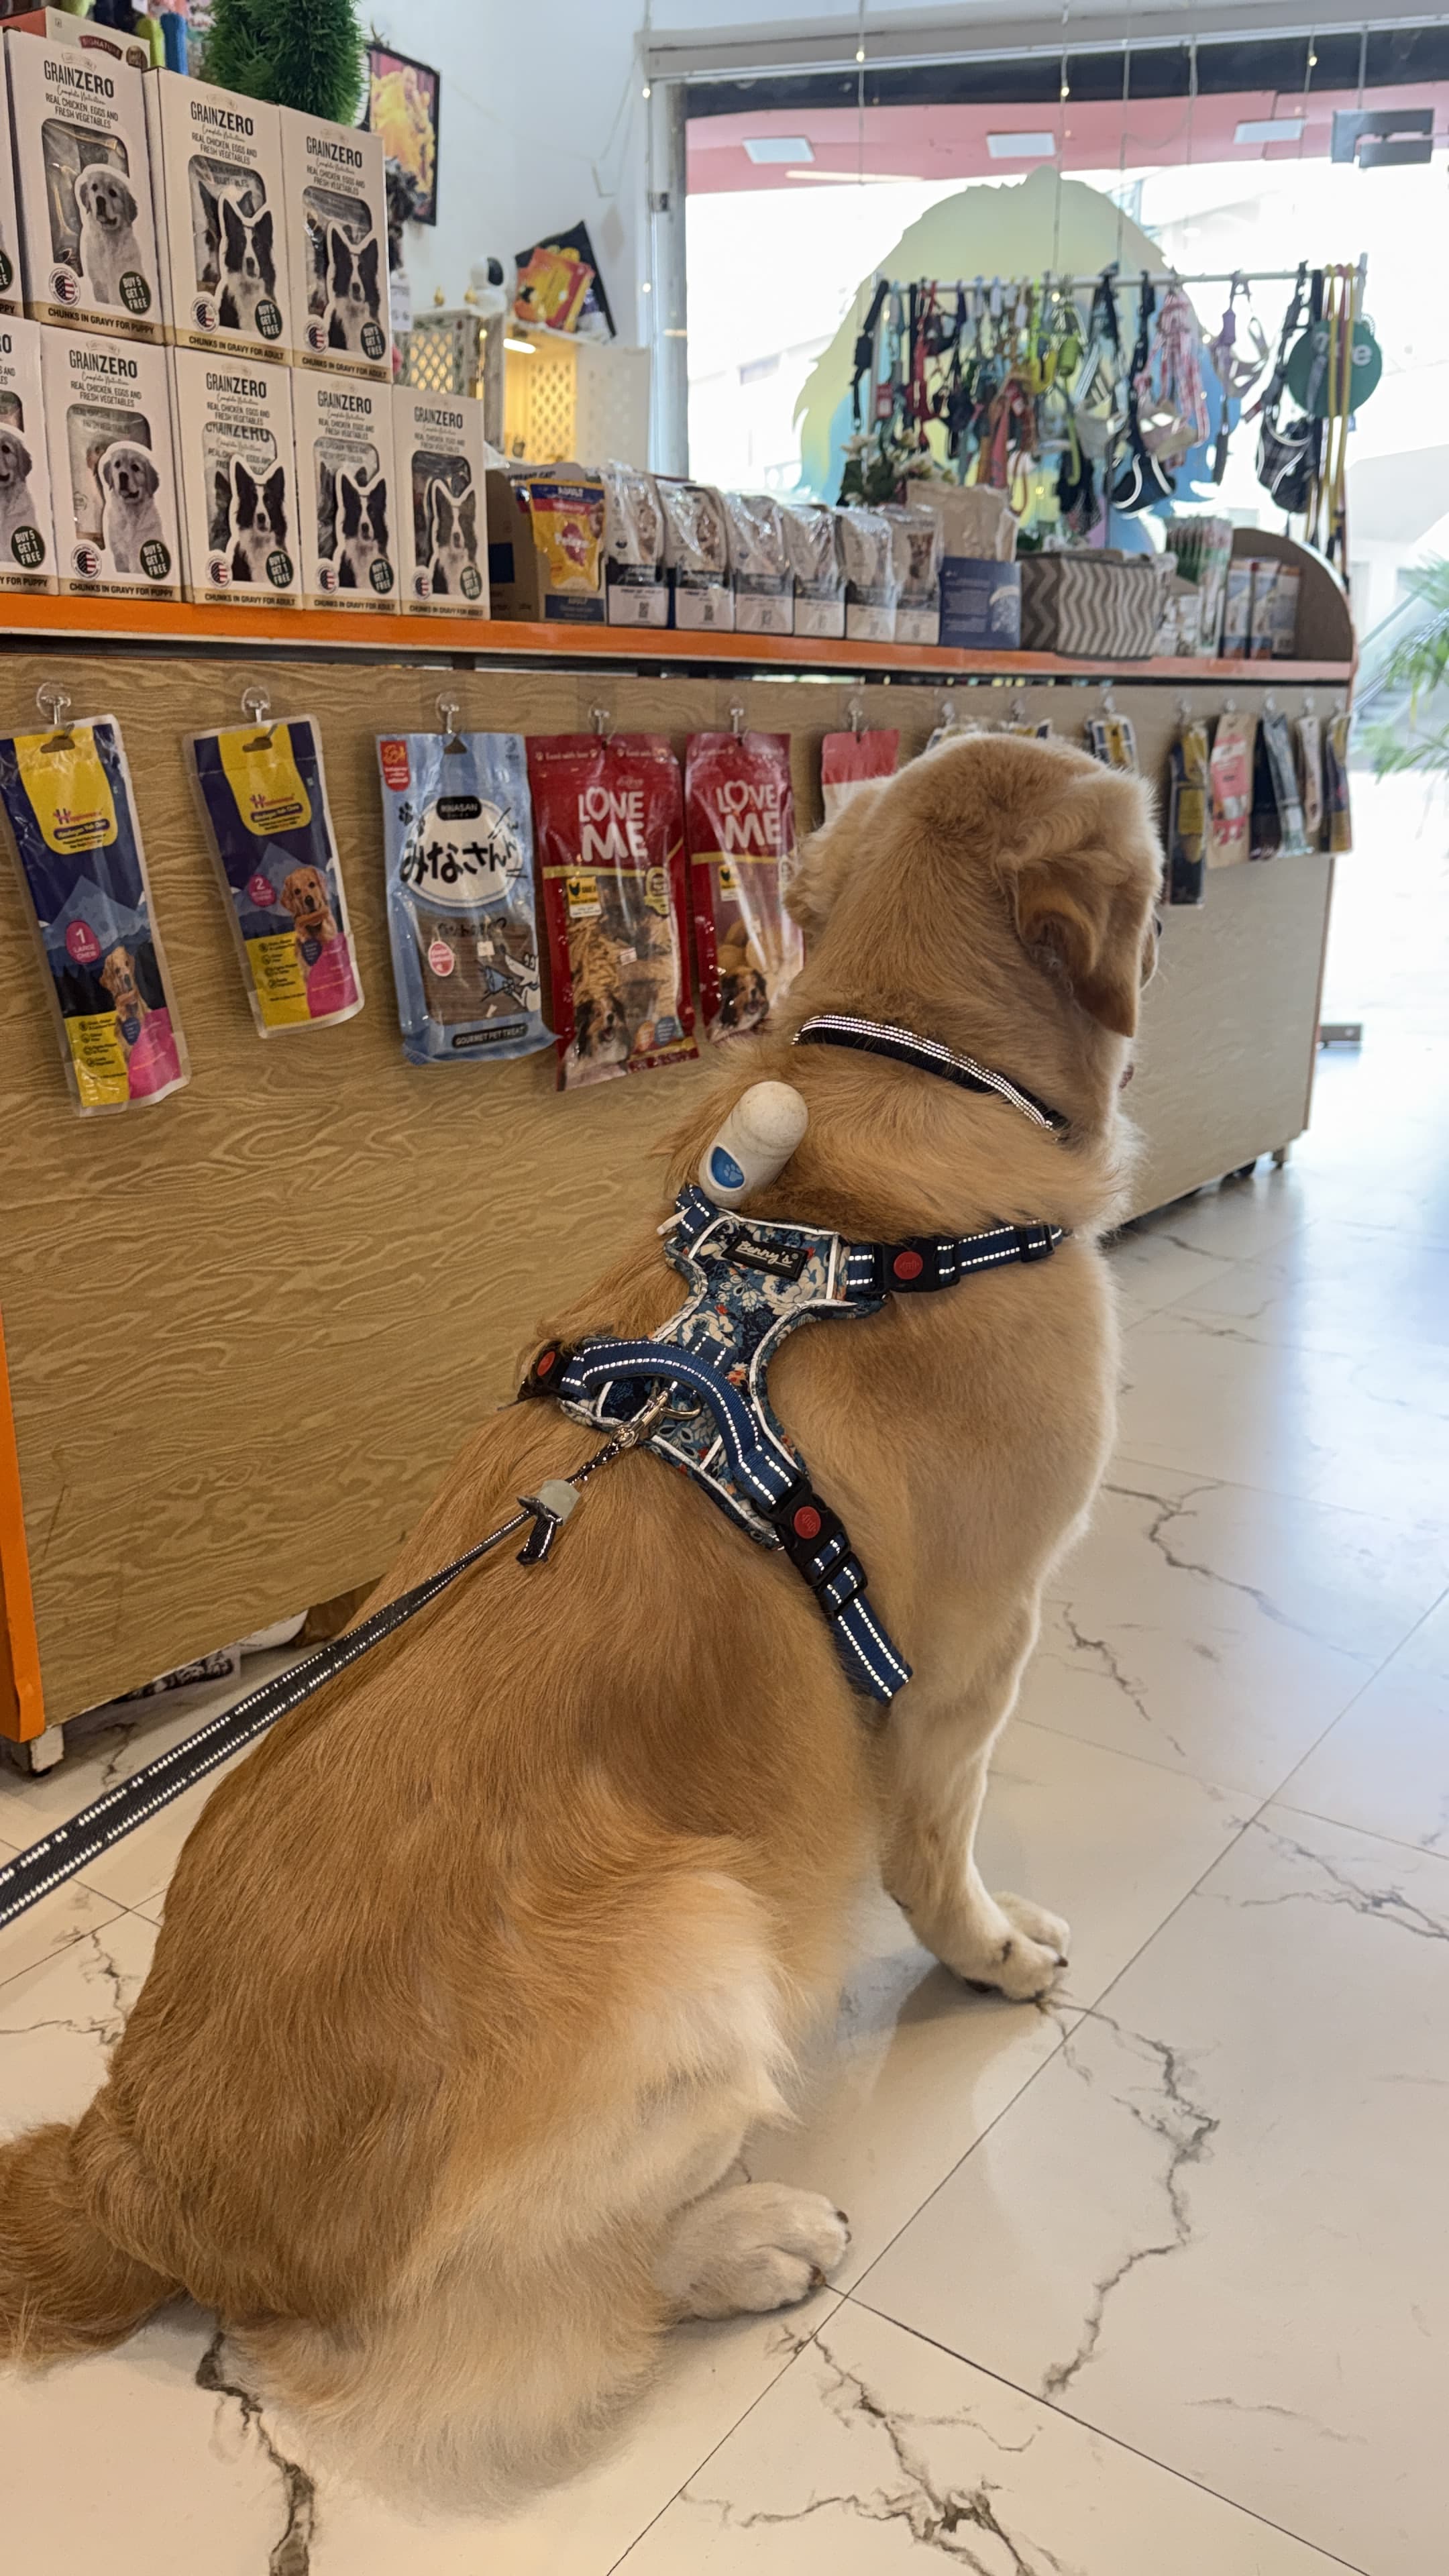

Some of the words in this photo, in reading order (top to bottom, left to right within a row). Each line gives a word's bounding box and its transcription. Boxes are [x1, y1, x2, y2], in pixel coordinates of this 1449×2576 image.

[44, 60, 114, 98] GRAINZERO
[46, 93, 60, 105] REAL
[91, 106, 105, 117] EGGS
[107, 110, 118, 121] AND
[55, 106, 74, 118] FRESH
[75, 111, 111, 129] VEGETABLES
[191, 101, 254, 136] GRAINZERO
[192, 132, 205, 143] REAL
[307, 136, 362, 168] GRAINZERO
[123, 277, 136, 288] BUY
[125, 288, 138, 299] GET
[140, 287, 144, 297] 1
[128, 298, 148, 309] FREE
[48, 308, 79, 321] CHUNKS
[81, 314, 89, 323] IN
[91, 316, 114, 327] GRAVY
[116, 321, 129, 331] FOR
[131, 323, 154, 334] PUPPY
[272, 313, 276, 323] 1
[262, 324, 279, 335] FREE
[189, 336, 217, 348] CHUNKS
[227, 343, 249, 354] GRAVY
[250, 347, 262, 356] FOR
[70, 350, 138, 378] GRAINZERO
[3, 366, 15, 377] AND
[70, 381, 85, 390] REAL
[206, 372, 266, 398] GRAINZERO
[15, 531, 29, 543] BUY
[29, 530, 35, 539] 5
[17, 542, 31, 553] GET
[33, 541, 38, 549] 1
[143, 545, 156, 556] BUY
[156, 543, 162, 552] 5
[21, 551, 41, 564] FREE
[146, 555, 158, 566] GET
[159, 554, 164, 562] 1
[148, 564, 167, 576] FREE
[6, 577, 21, 585] FOR
[23, 578, 47, 587] PUPPY
[274, 573, 290, 585] FREE
[70, 583, 101, 592] CHUNKS
[111, 586, 134, 594] GRAVY
[150, 589, 173, 597] PUPPY
[716, 780, 776, 813] LOVE
[578, 786, 644, 822] LOVE
[724, 812, 782, 849] ME
[582, 821, 648, 862] ME
[400, 842, 508, 885] みなさん
[255, 878, 266, 890] 2
[76, 928, 86, 944] 1
[73, 943, 95, 953] LARGE
